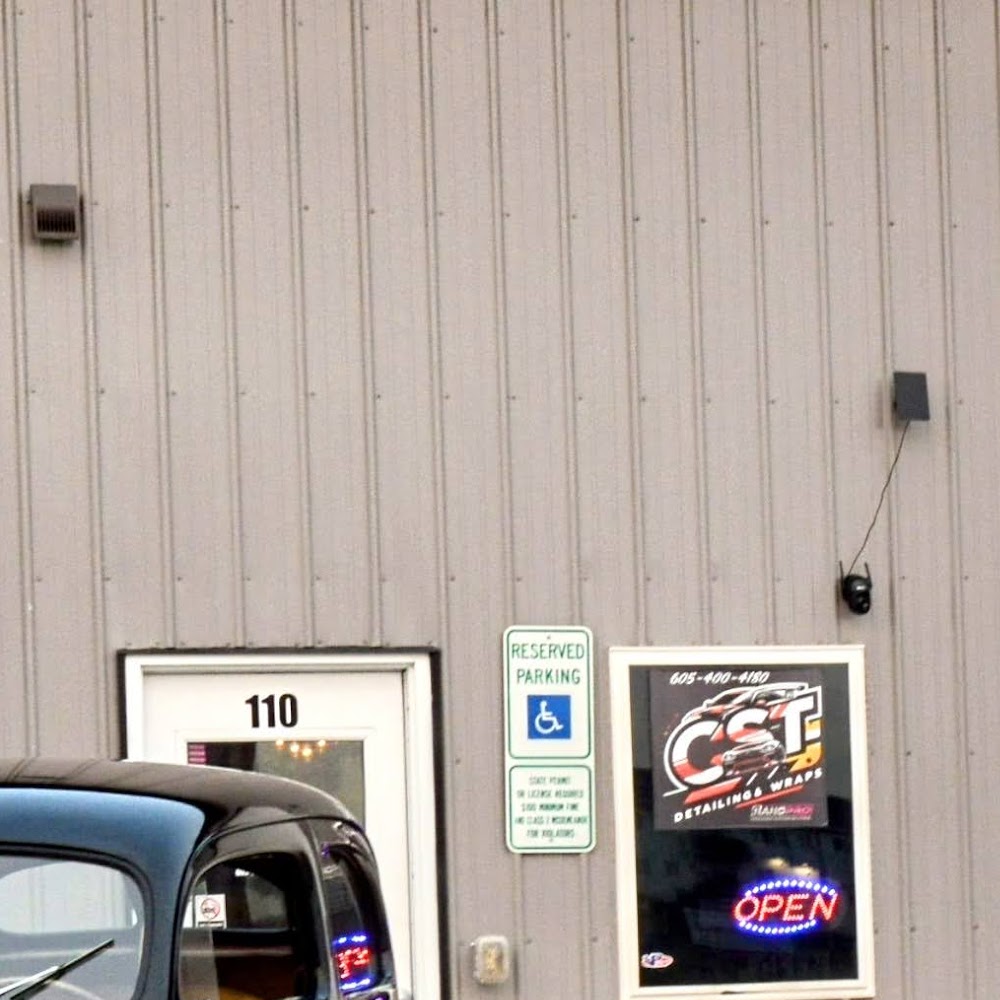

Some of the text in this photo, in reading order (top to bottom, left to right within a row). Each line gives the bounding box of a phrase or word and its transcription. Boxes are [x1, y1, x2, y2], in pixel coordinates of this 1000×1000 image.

[511, 643, 585, 659] RESERVED
[516, 668, 581, 685] PARKING
[244, 693, 299, 728] 110
[672, 695, 815, 785] CST
[770, 767, 823, 793] WRAPS
[734, 893, 838, 922] OPEN
